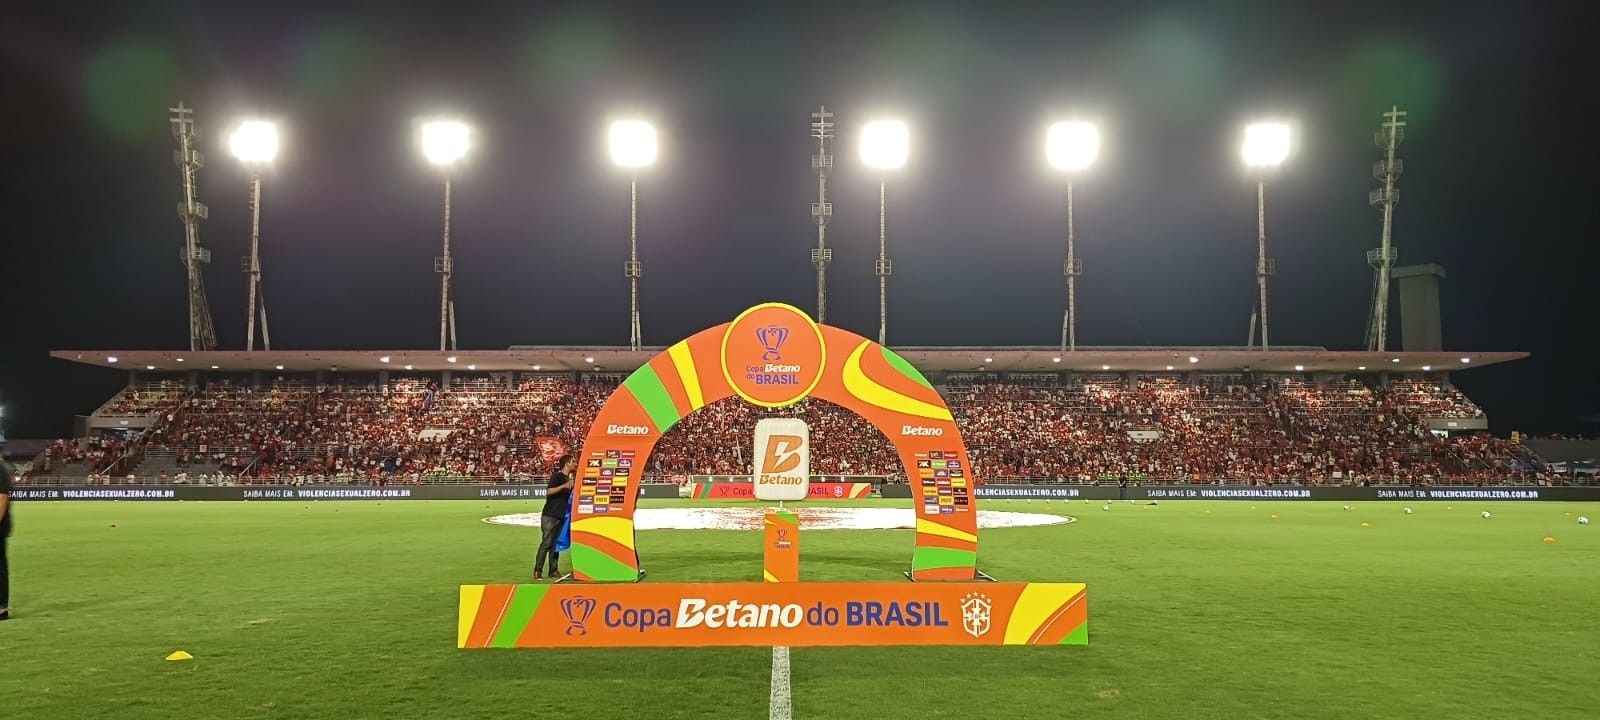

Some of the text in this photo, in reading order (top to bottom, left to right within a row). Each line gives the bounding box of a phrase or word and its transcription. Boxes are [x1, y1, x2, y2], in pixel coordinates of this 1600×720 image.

[746, 364, 801, 374] Copa Betano
[756, 375, 799, 384] BRASIL
[607, 424, 649, 434] Betano
[902, 425, 943, 436] Betano
[759, 474, 803, 485] Betano
[63, 490, 175, 498] VIOLENCIASEXUALZERO.COM.BR
[298, 489, 411, 497] VIOLENCIASEXUALZERO.COM.BR
[480, 489, 499, 497] SAIBA
[501, 489, 518, 497] MAIS
[974, 488, 1080, 497] IOLENCIASEXUALZERO.COM.BR
[1147, 489, 1167, 497] SAIBA
[1168, 489, 1185, 497] MAIS
[1201, 489, 1311, 497] VIOLENCIASEXUALZERO.COM.BR
[1377, 490, 1397, 498] SAIBA
[1430, 490, 1539, 498] VIOLENCIASEXUALZERO.COM.BR
[604, 598, 949, 632] Copa Betano do BRASIL
